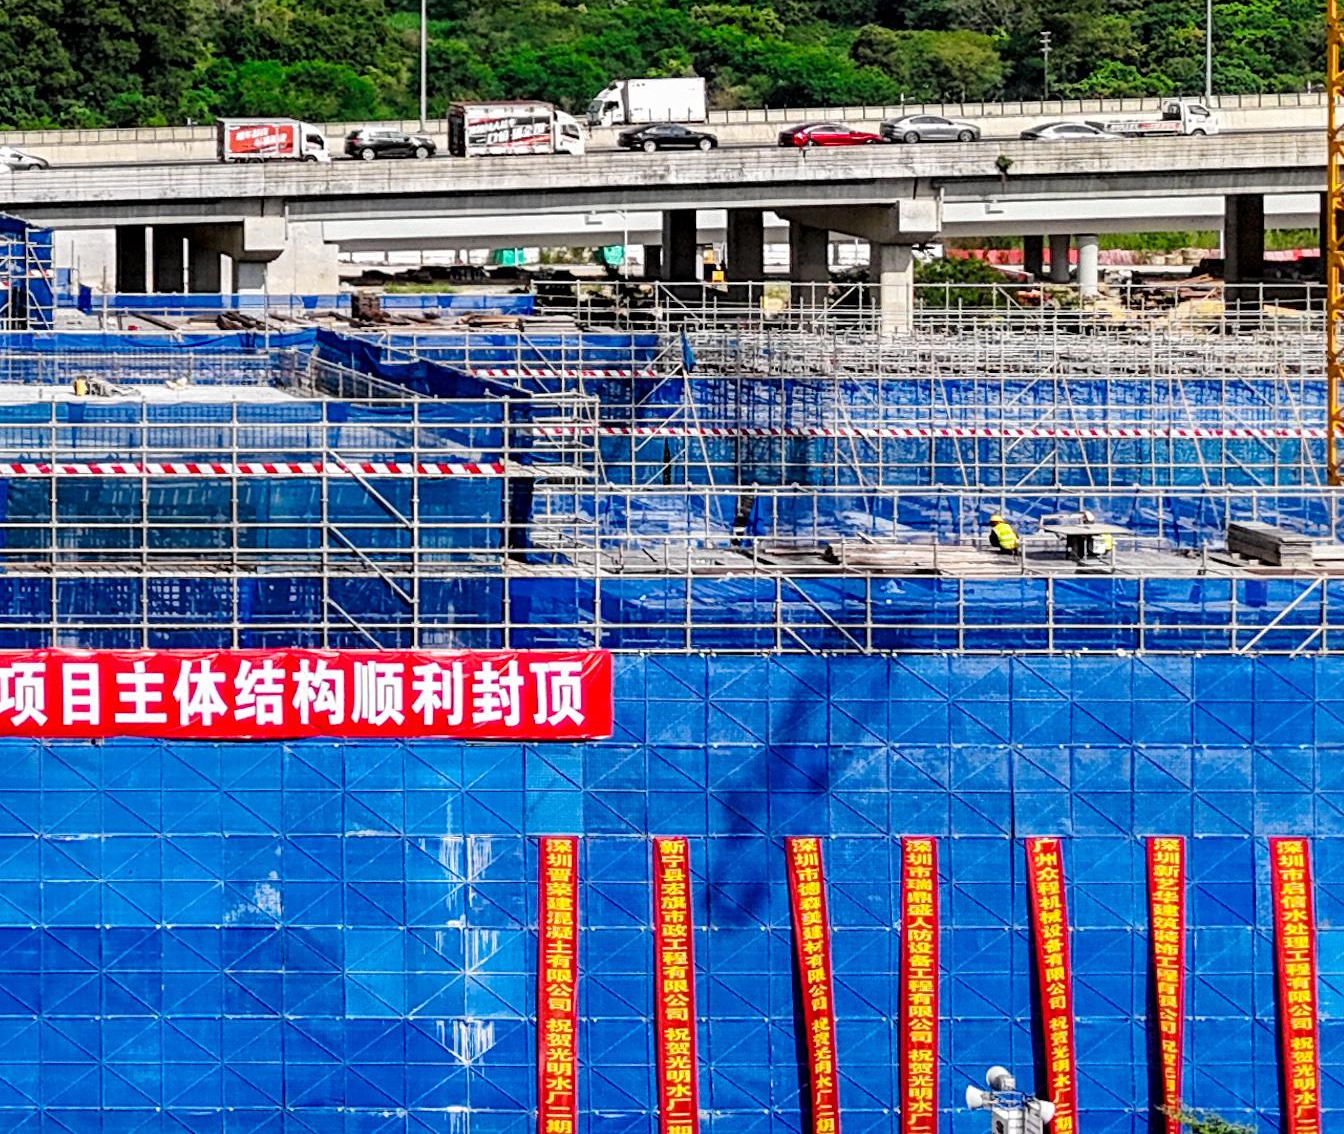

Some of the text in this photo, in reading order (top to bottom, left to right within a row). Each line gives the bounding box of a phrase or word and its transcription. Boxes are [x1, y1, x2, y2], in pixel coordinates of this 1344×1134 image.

[906, 840, 934, 1044] 深圳市瑞鼎盛人防设备工程有限公司
[1290, 1037, 1317, 1134] 祝贺光明水厂二
